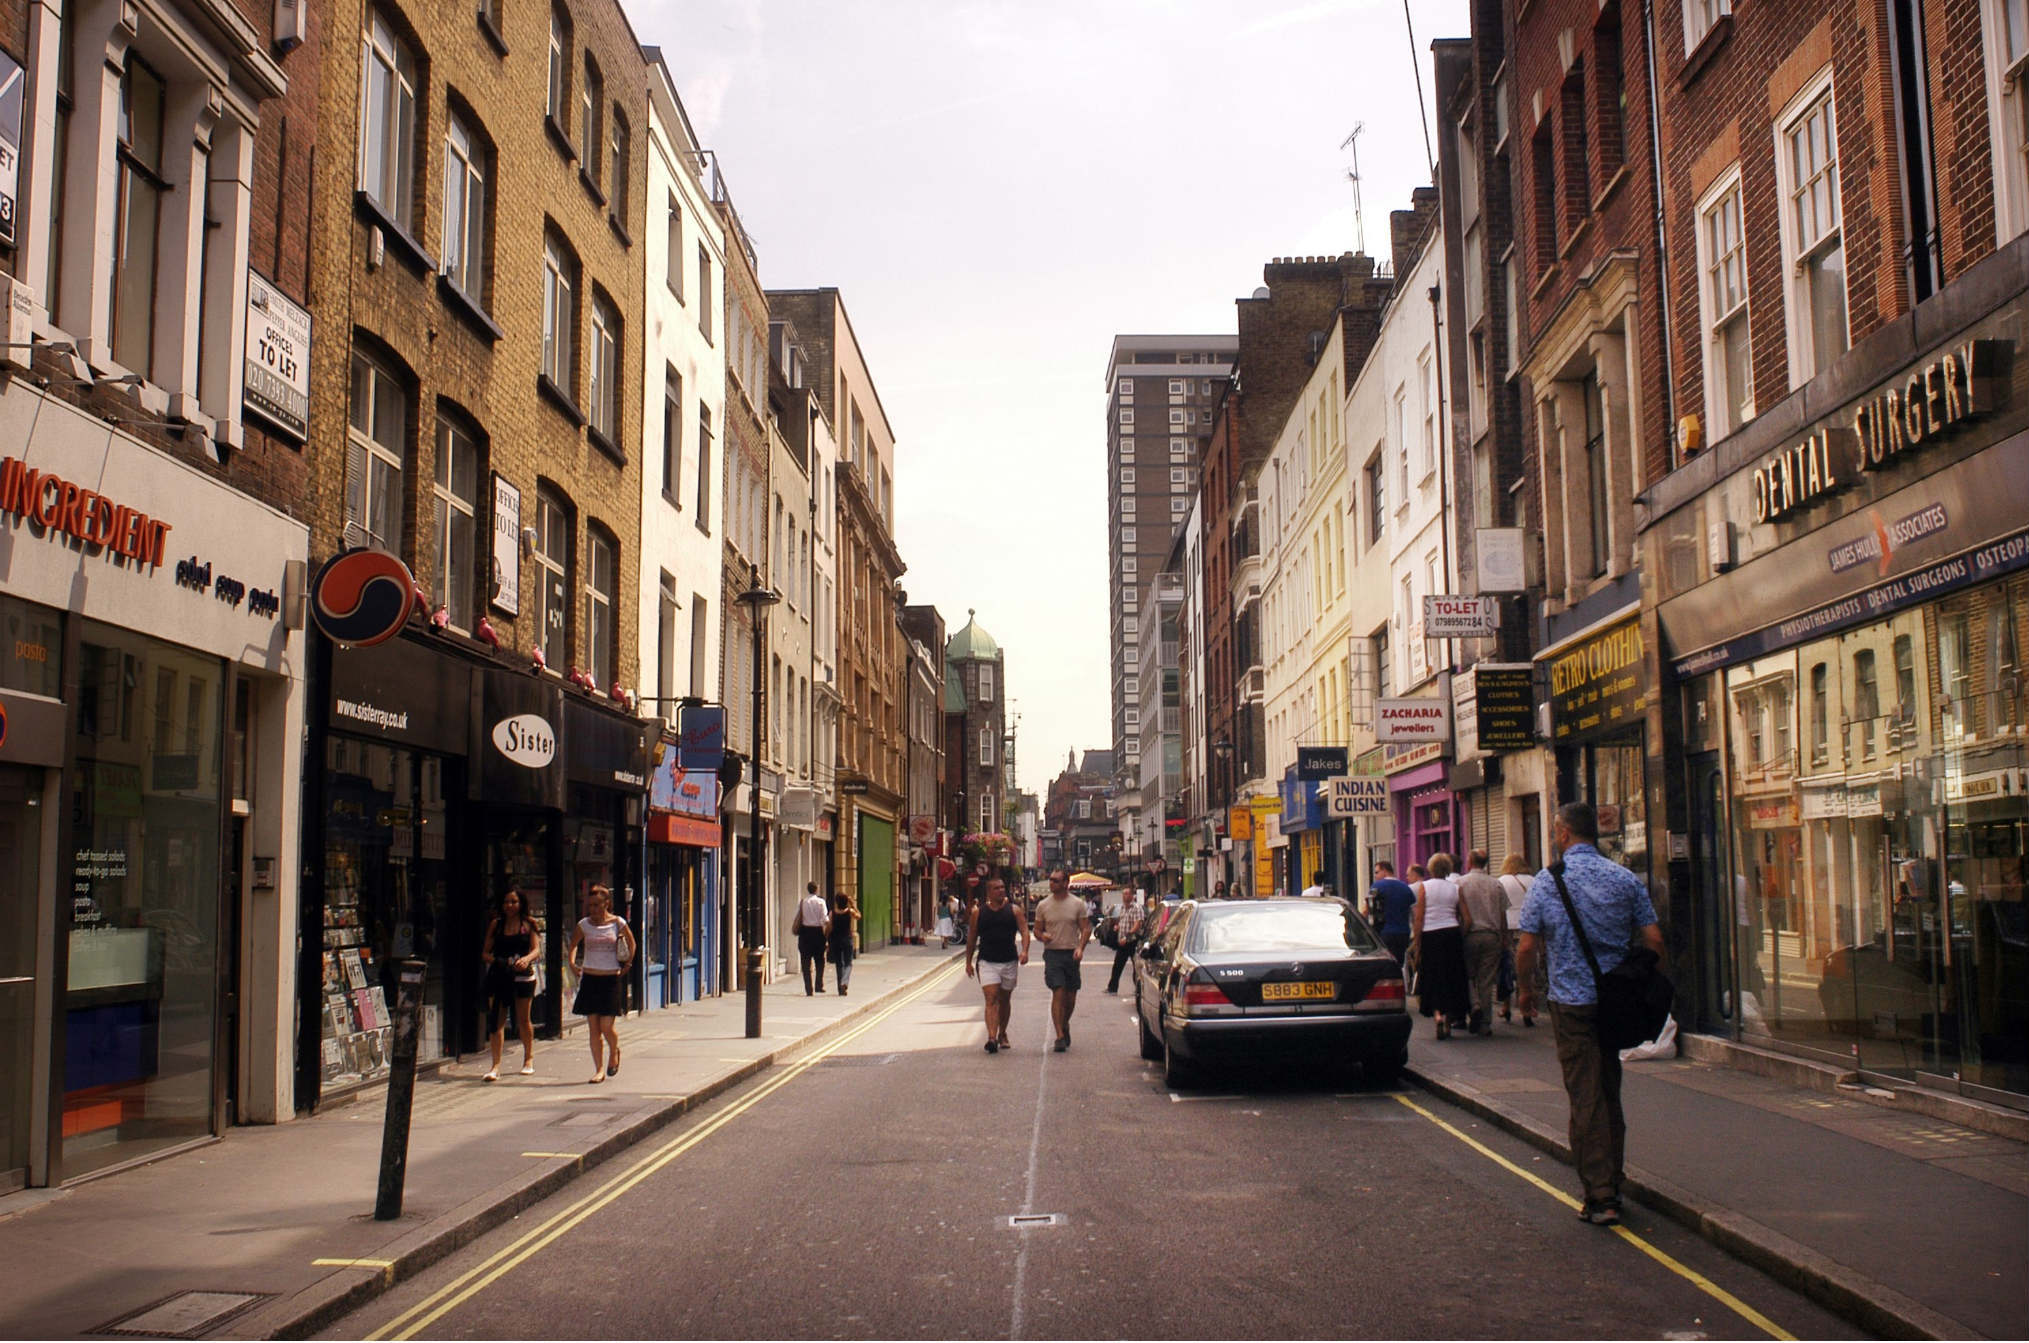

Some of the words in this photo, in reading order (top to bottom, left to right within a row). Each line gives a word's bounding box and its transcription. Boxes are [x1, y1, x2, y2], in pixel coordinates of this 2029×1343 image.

[259, 338, 276, 367] TO
[279, 353, 298, 382] LET
[1753, 428, 1836, 524] DENTAL
[1854, 339, 1976, 473] SURGERY
[0, 456, 173, 567] INGREDIENT
[496, 512, 507, 534] TO
[1830, 545, 1857, 571] JAMES
[1855, 533, 1880, 562] HULL
[1890, 505, 1946, 546] ASSOCIATES
[1435, 602, 1479, 614] TO-LET
[1780, 598, 1861, 638] PHYSIOTHERAPISTS
[1867, 582, 1908, 608] DENTAL
[1908, 559, 1966, 593] SURGEONS
[15, 640, 48, 662] pasta
[1552, 649, 1587, 697] RETRO
[337, 699, 408, 730] www.sisterray.co.uk
[1382, 708, 1443, 719] ZACHARIA
[505, 720, 553, 755] Sister
[1391, 723, 1435, 735] jewellers
[1305, 758, 1342, 769] Jakes
[1336, 781, 1386, 795] INDIAN
[1335, 797, 1387, 812] CUISINE
[1304, 983, 1333, 996] GNH
